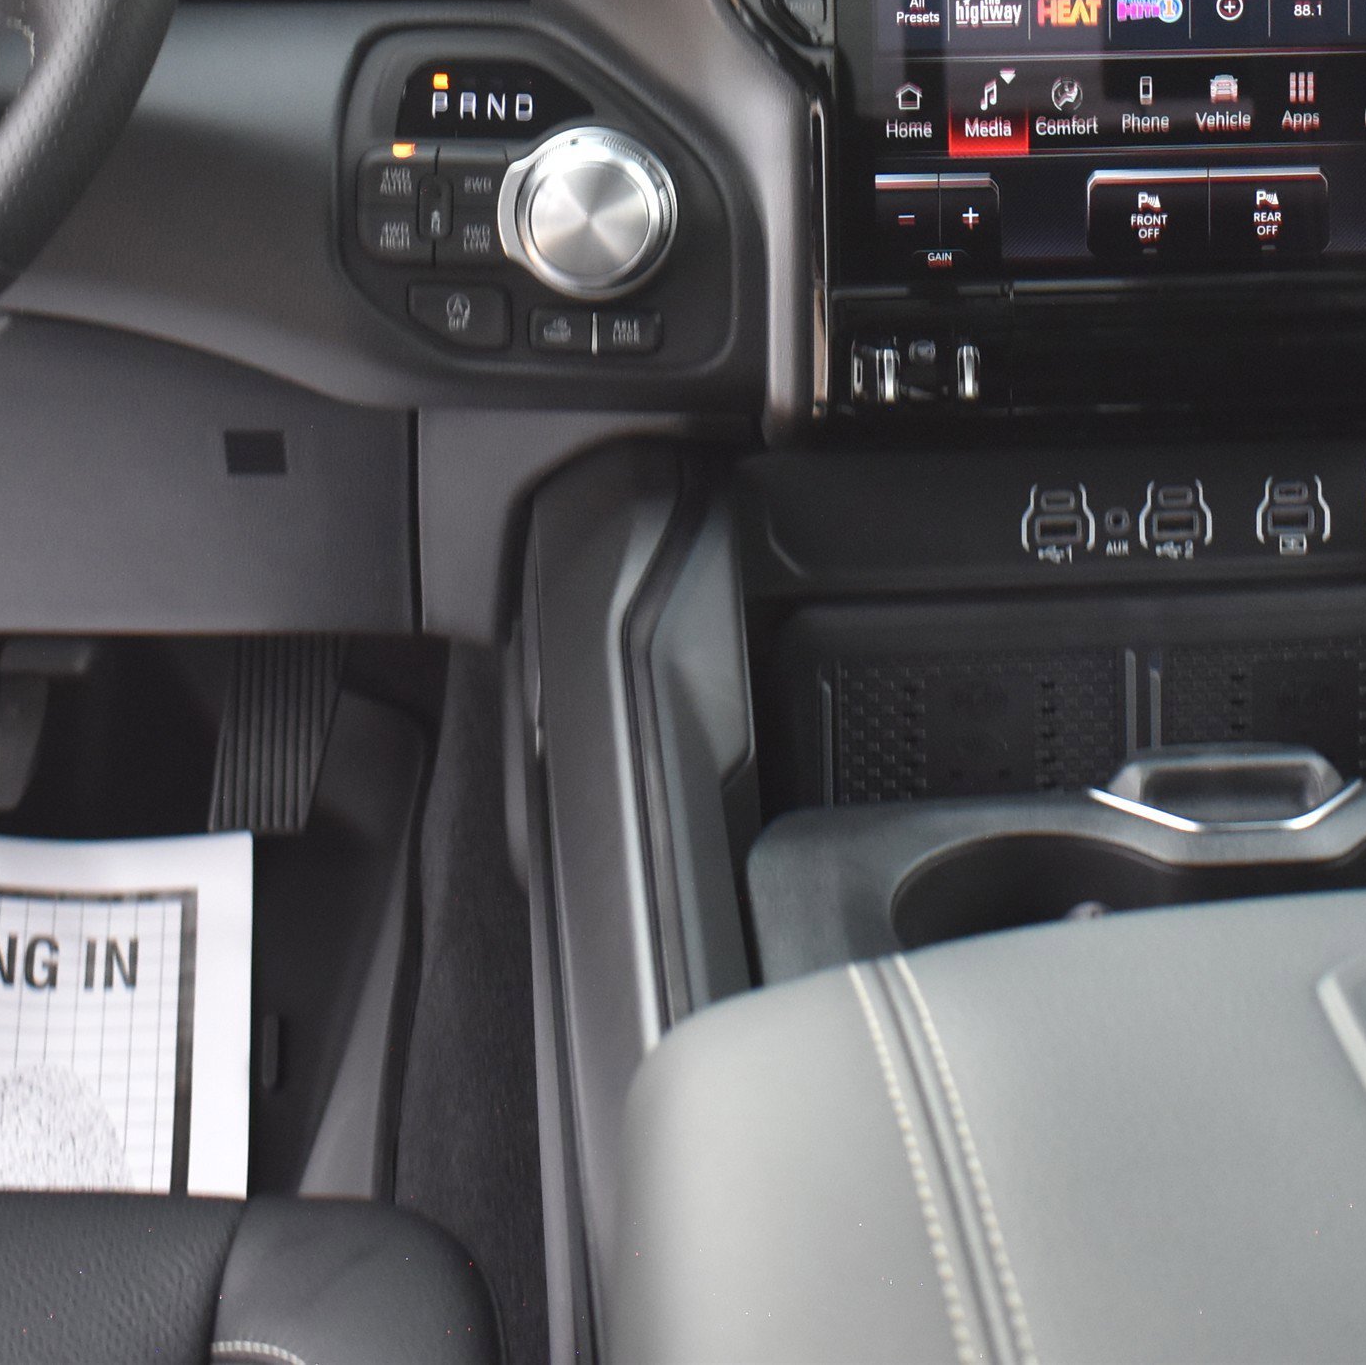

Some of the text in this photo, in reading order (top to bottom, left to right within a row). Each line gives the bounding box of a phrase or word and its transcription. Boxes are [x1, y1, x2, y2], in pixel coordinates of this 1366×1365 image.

[896, 11, 941, 26] Presets
[1293, 2, 1323, 18] 88.1
[431, 90, 534, 122] P R N D
[885, 119, 933, 139] Home
[964, 117, 1013, 139] Media
[1035, 115, 1099, 137] Comfort
[1121, 113, 1170, 134] Phone
[1195, 110, 1253, 132] Vehicle
[1281, 110, 1321, 133] Apps
[1130, 214, 1168, 227] FRONT
[1253, 211, 1283, 224] REAR
[1137, 227, 1161, 241] OFF
[1256, 225, 1279, 237] OFF
[927, 252, 953, 264] GAIN
[1105, 538, 1130, 557] AUX
[84, 936, 139, 993] IN
